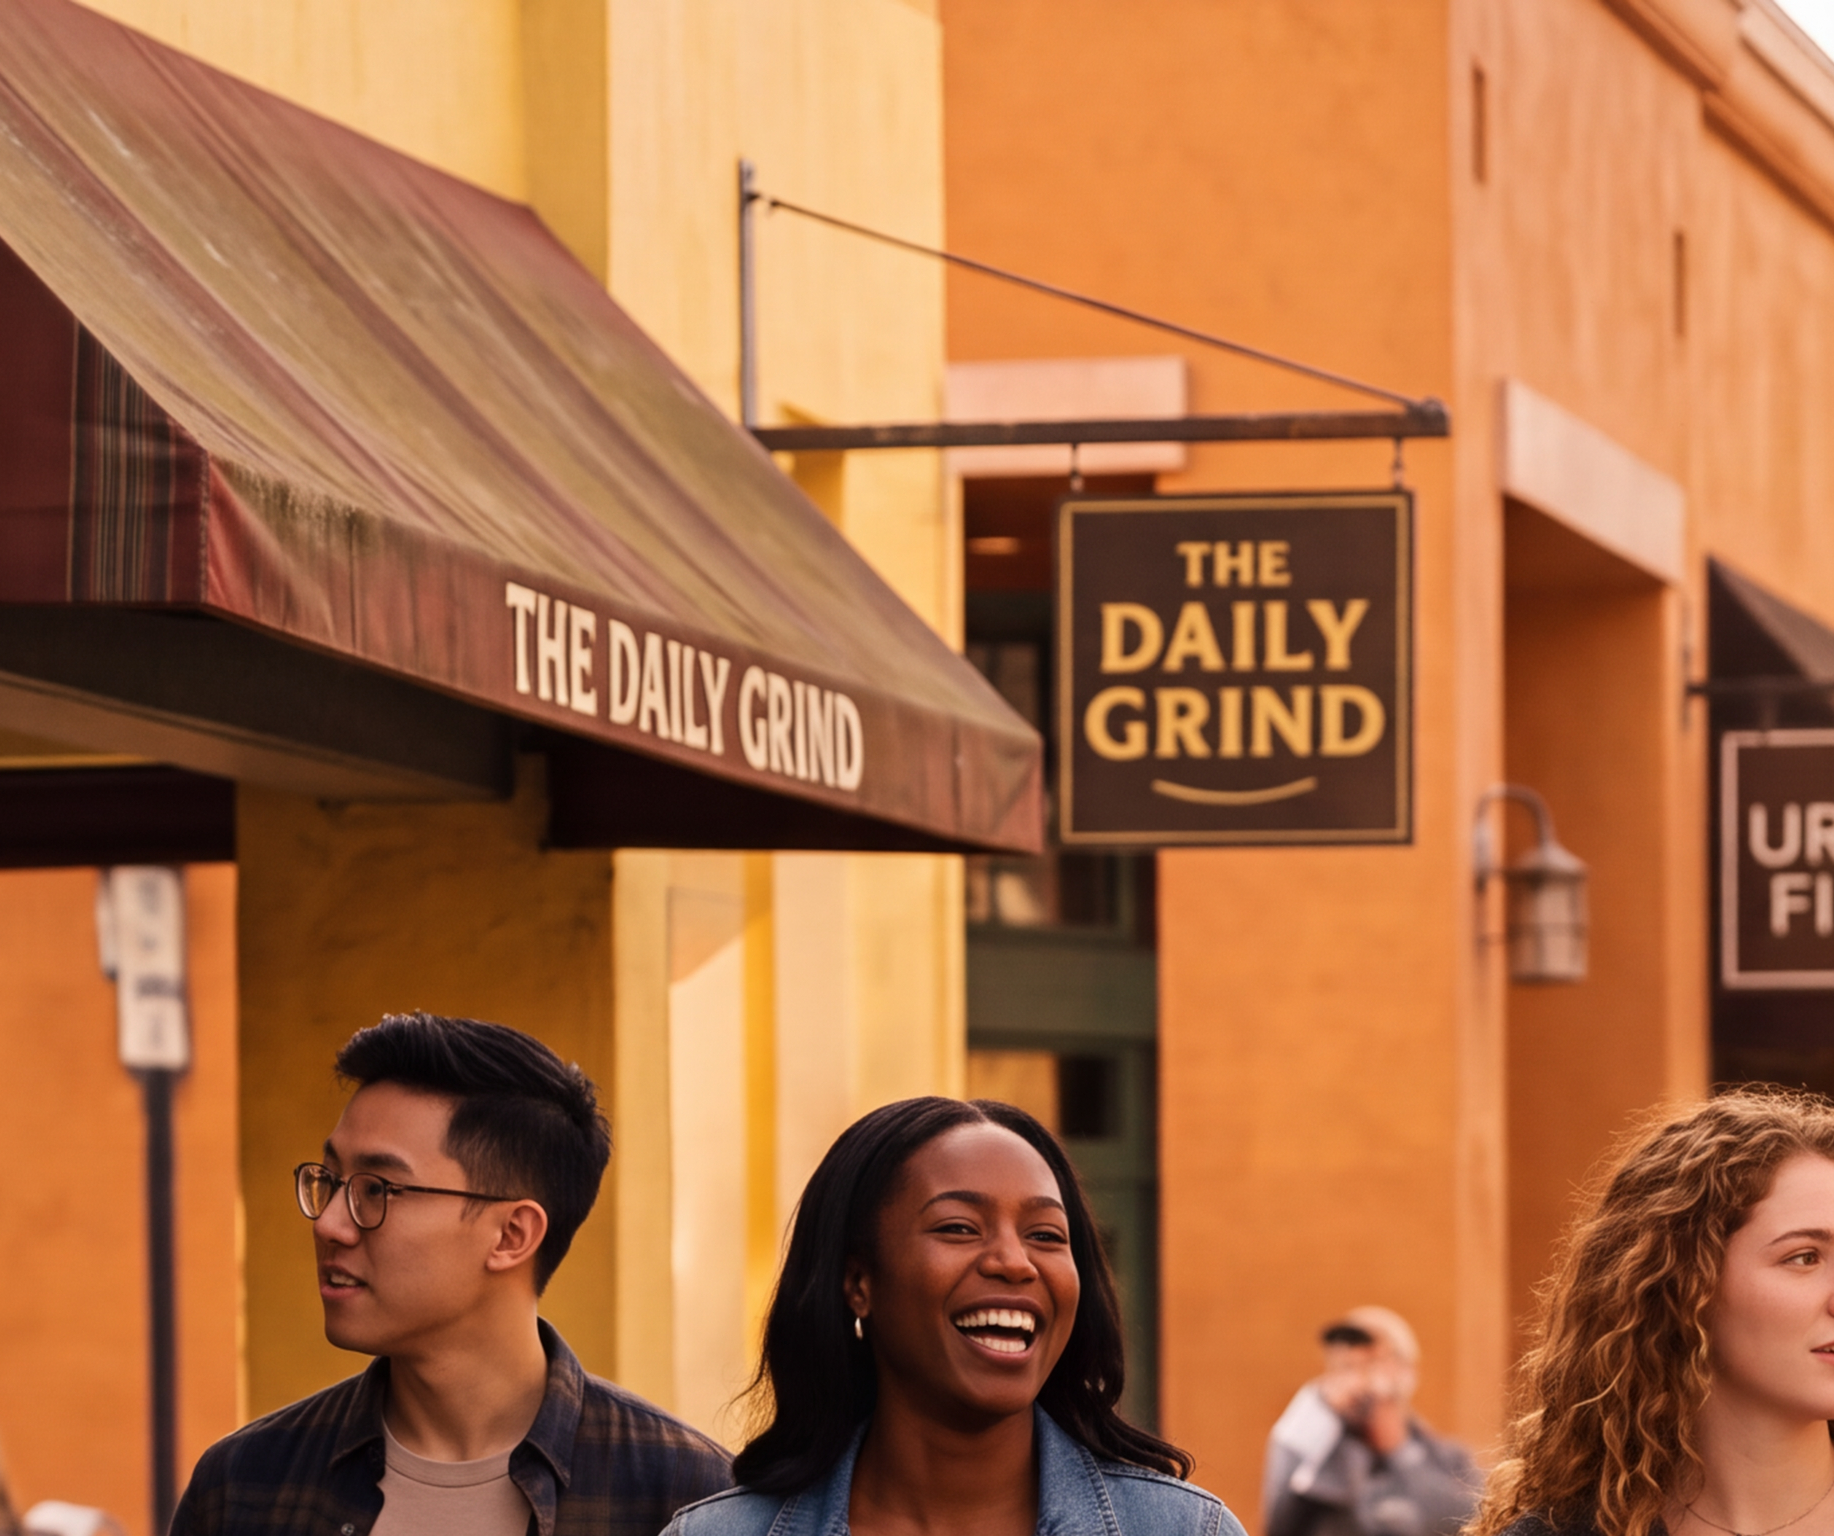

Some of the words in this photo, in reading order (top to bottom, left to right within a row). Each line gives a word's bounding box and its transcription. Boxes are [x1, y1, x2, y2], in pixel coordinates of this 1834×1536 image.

[1177, 541, 1291, 587] THE
[1100, 599, 1369, 674] DAILY
[505, 581, 598, 717] THE
[608, 618, 732, 757] DAILY
[738, 664, 864, 792] GRIND
[1084, 684, 1386, 761] GRIND
